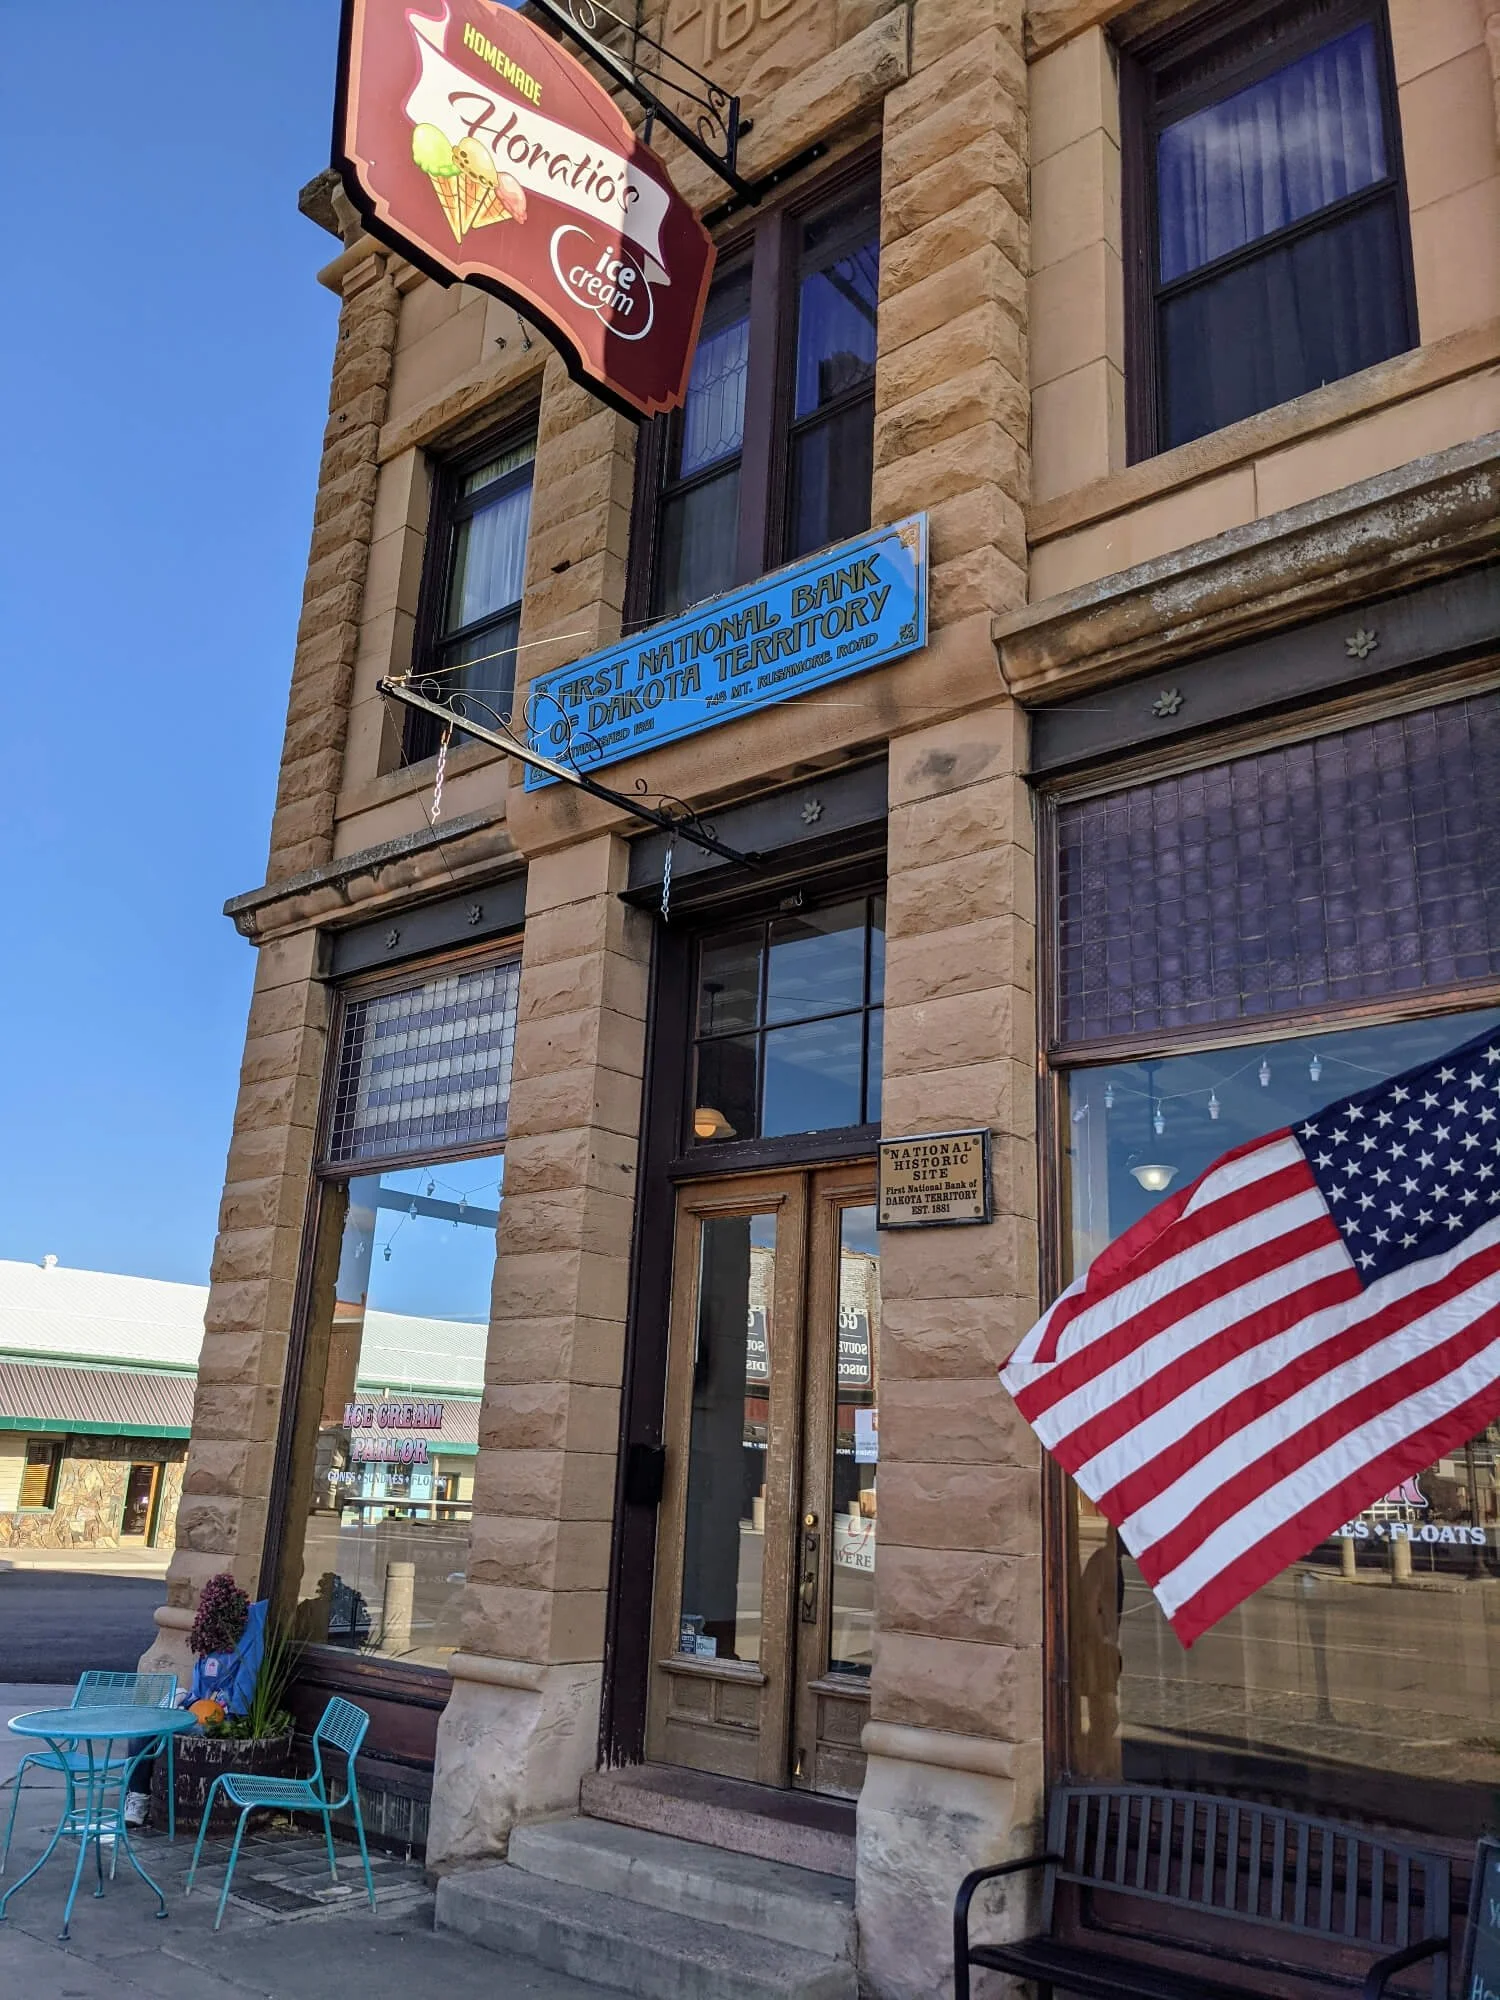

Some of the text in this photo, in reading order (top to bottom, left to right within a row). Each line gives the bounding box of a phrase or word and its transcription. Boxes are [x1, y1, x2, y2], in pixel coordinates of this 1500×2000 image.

[463, 22, 543, 107] HOMEMADE
[448, 91, 640, 214] Horatio's
[595, 246, 636, 289] ice
[569, 265, 634, 316] cream
[558, 553, 881, 713] FIRST NATIONAL BANK
[550, 584, 891, 745] OF DAKOTA TERRITORY
[731, 681, 753, 700] MT.
[757, 651, 832, 690] RUSHMORE
[837, 633, 878, 659] ROAD
[890, 1142, 972, 1159] NATIONAL
[894, 1154, 969, 1171] HISTORIC
[886, 1179, 977, 1195] First National Bank of
[913, 1168, 949, 1180] SITE
[885, 1190, 978, 1206] DAKOTA TERRITORY
[911, 1204, 950, 1215] EST. 1881
[343, 1403, 444, 1430] ICE CREAM
[352, 1437, 429, 1464] PARLOR
[363, 1472, 403, 1485] SUNDAES
[1390, 1523, 1487, 1545] FLOATS
